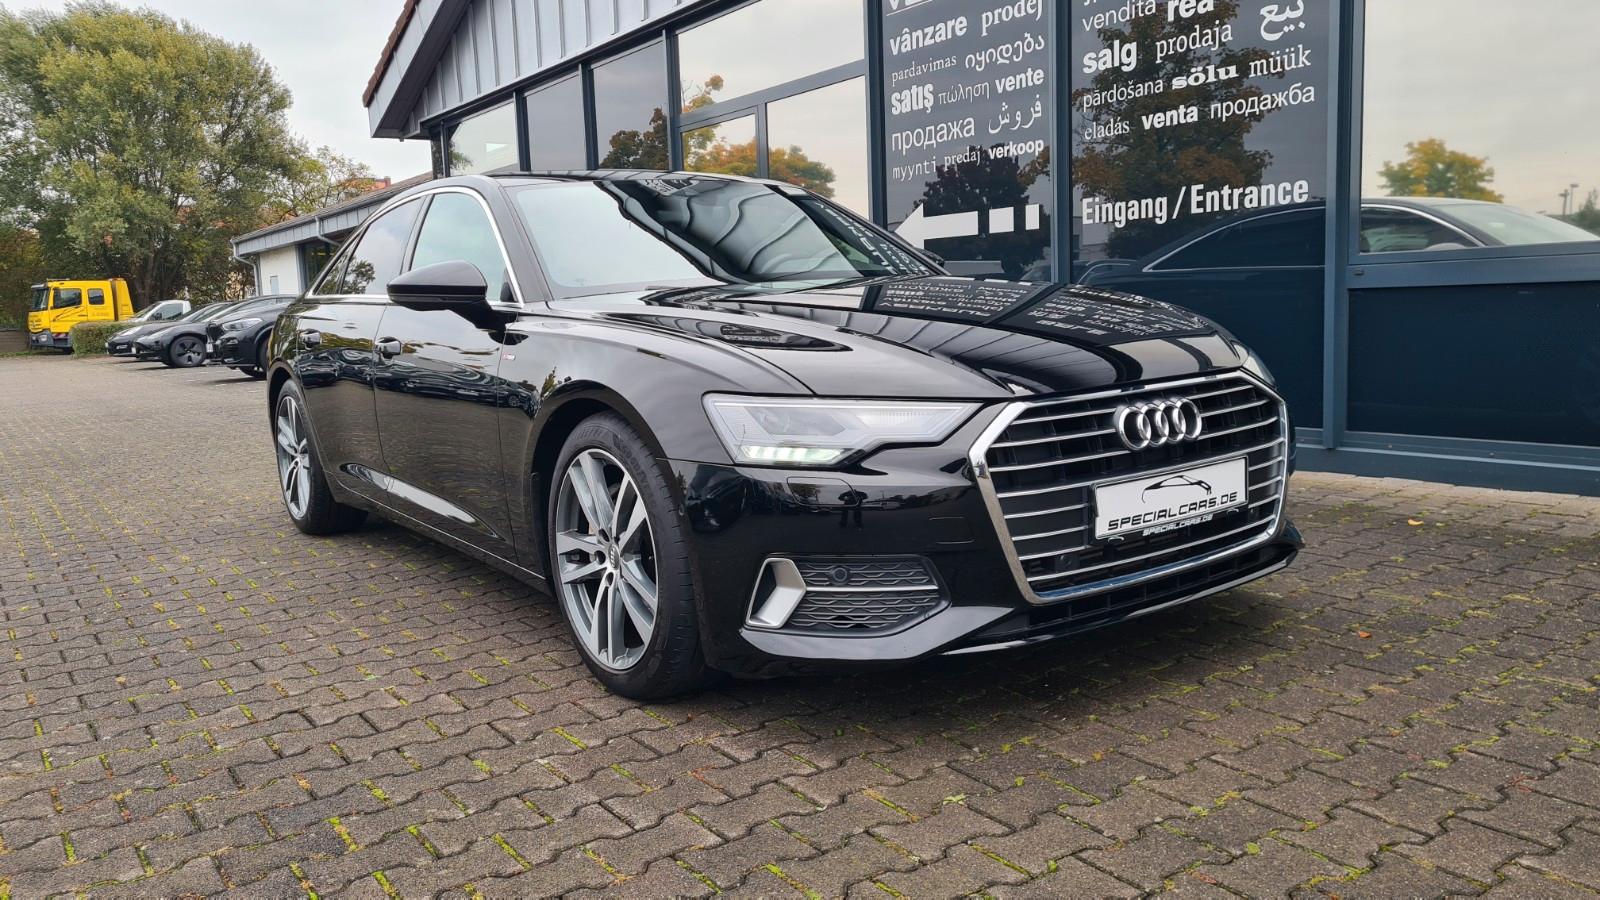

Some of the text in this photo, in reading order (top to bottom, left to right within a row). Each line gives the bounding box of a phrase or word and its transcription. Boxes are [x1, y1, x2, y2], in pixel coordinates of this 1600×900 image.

[1082, 0, 1156, 31] vendita
[890, 15, 967, 56] vânzare
[1083, 20, 1233, 74] salg prodaja
[892, 56, 957, 87] pardavimas
[995, 68, 1044, 94] vente
[1083, 44, 1312, 112] pārdošana sölu müük
[891, 83, 934, 115] satış
[938, 82, 990, 105] πώληση
[1210, 82, 1315, 121] продажба
[891, 116, 975, 155] продажа
[1084, 104, 1199, 141] eladás venta
[892, 139, 1044, 182] myynti predaj verkoop
[1082, 196, 1168, 228] Eingang
[1191, 179, 1309, 214] Entrance
[1107, 491, 1238, 531] SPECIALCARS.DE
